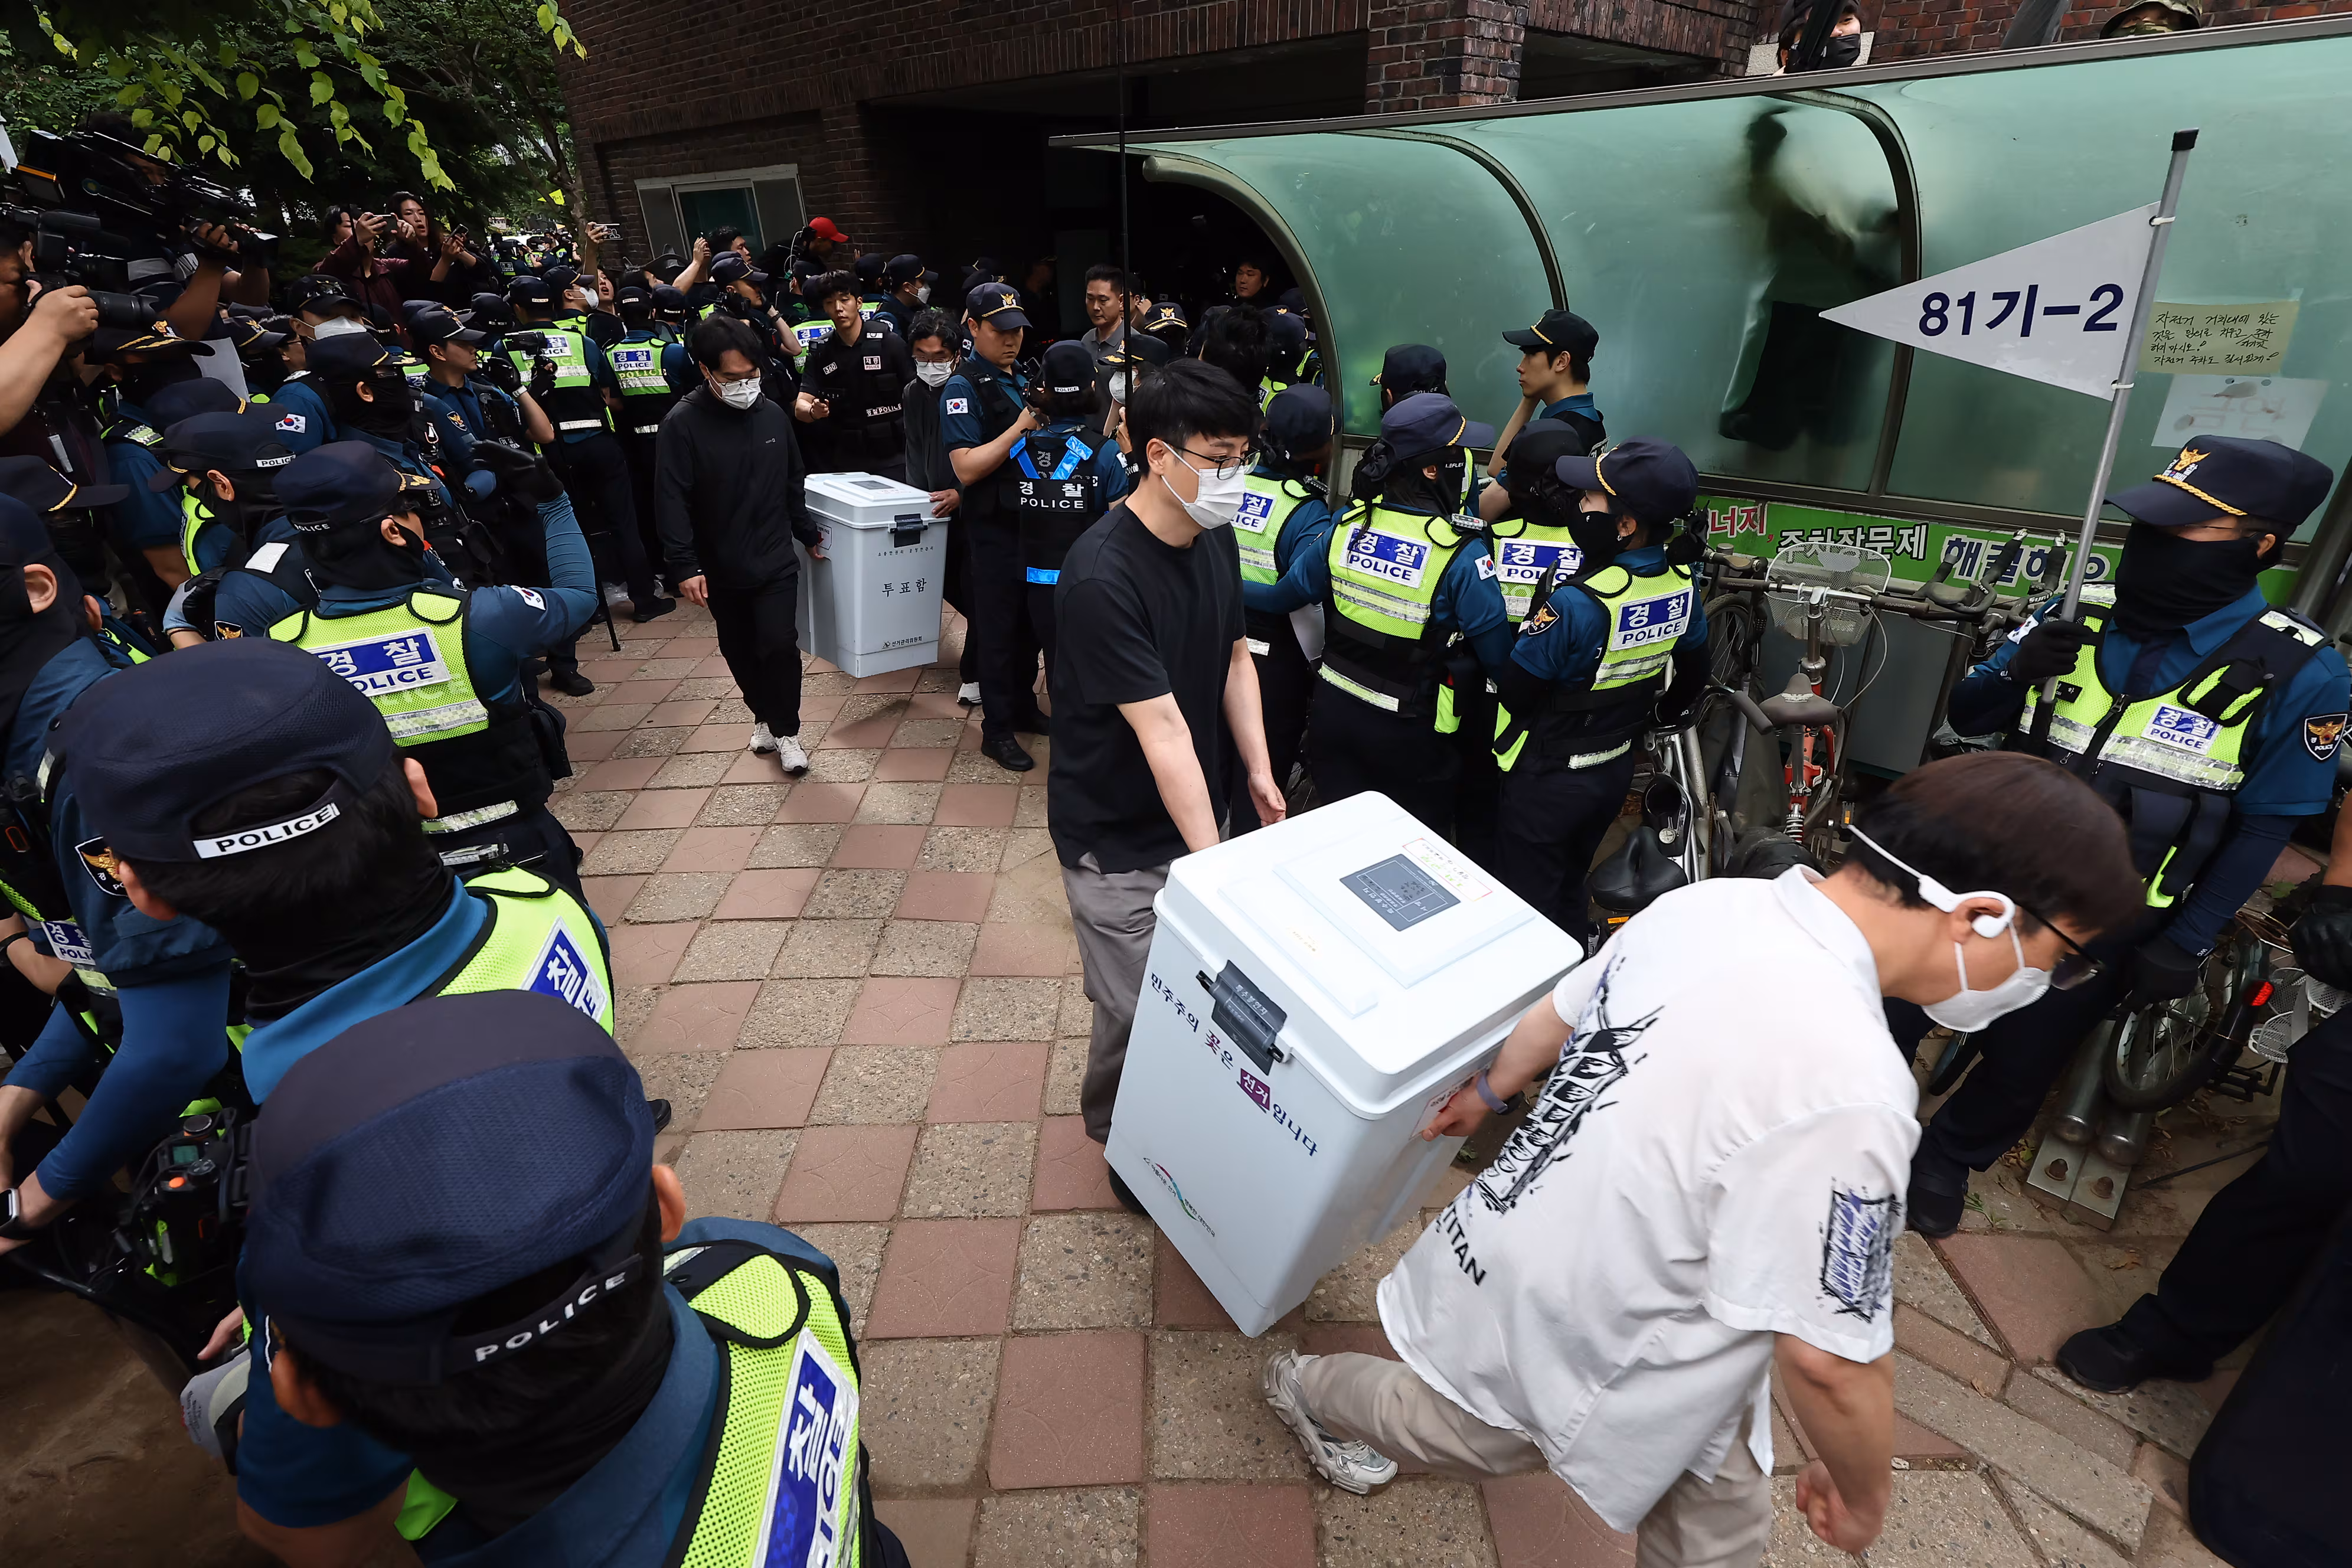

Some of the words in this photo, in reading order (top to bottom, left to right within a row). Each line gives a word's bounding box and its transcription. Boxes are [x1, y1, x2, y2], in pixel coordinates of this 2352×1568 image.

[1919, 283, 2124, 338] 81기-2
[2155, 311, 2194, 328] 자전거
[2206, 314, 2250, 325] 거치대에
[2258, 312, 2279, 325] 있는
[2152, 328, 2175, 342] 것을
[617, 351, 647, 362] 경찰
[2150, 343, 2166, 352] 하지
[825, 364, 837, 373] 360
[2154, 355, 2183, 365] 자전거
[2189, 355, 2219, 364] 주차도
[878, 404, 902, 413] POLICE
[1020, 481, 1084, 497] 경찰
[1021, 497, 1084, 509] POLICE
[1360, 533, 1419, 567] 경찰
[1511, 544, 1584, 569] 경찰
[1349, 554, 1412, 581] POLICE
[1507, 568, 1569, 582] POLC
[882, 577, 927, 597] 투표함
[1628, 596, 1685, 628] 경찰
[891, 636, 922, 647] 선거관리위원회
[1622, 622, 1681, 645] POLICE
[319, 639, 423, 676] 경찰
[354, 667, 434, 692] OLICE
[2158, 708, 2214, 737] 경찰
[2150, 729, 2204, 749] POLICE
[216, 806, 332, 854] POLICE
[60, 948, 93, 961] POLI
[1151, 972, 1199, 1033] 민주주의
[1205, 1029, 1233, 1070] 꽃은
[475, 1272, 626, 1361] POLICE
[789, 1383, 828, 1483] 찰
